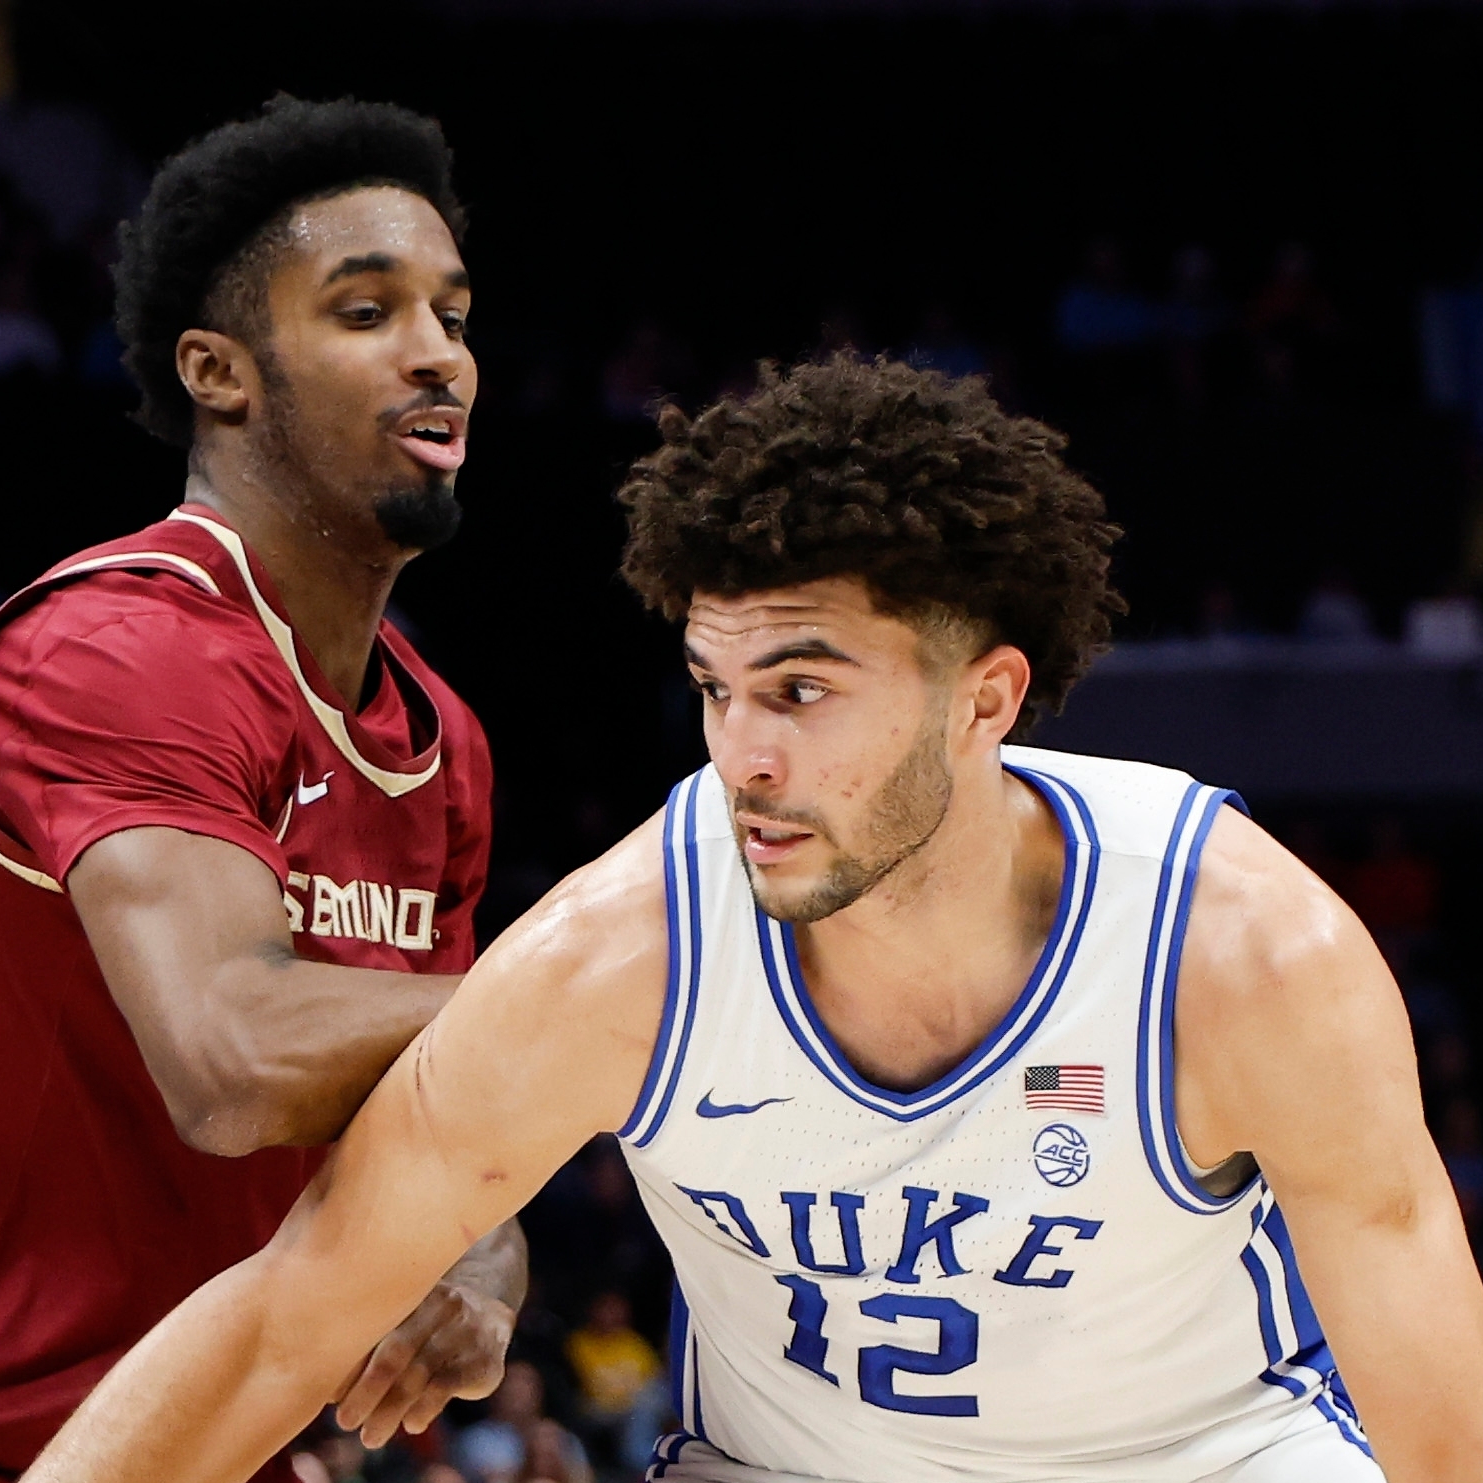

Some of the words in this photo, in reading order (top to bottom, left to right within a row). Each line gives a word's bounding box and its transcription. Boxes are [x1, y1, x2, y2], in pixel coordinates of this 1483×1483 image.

[283, 871, 439, 950] SEMINO
[1041, 1144, 1088, 1163] ACC
[674, 1182, 1104, 1289] DUKE
[775, 1274, 980, 1418] 12
